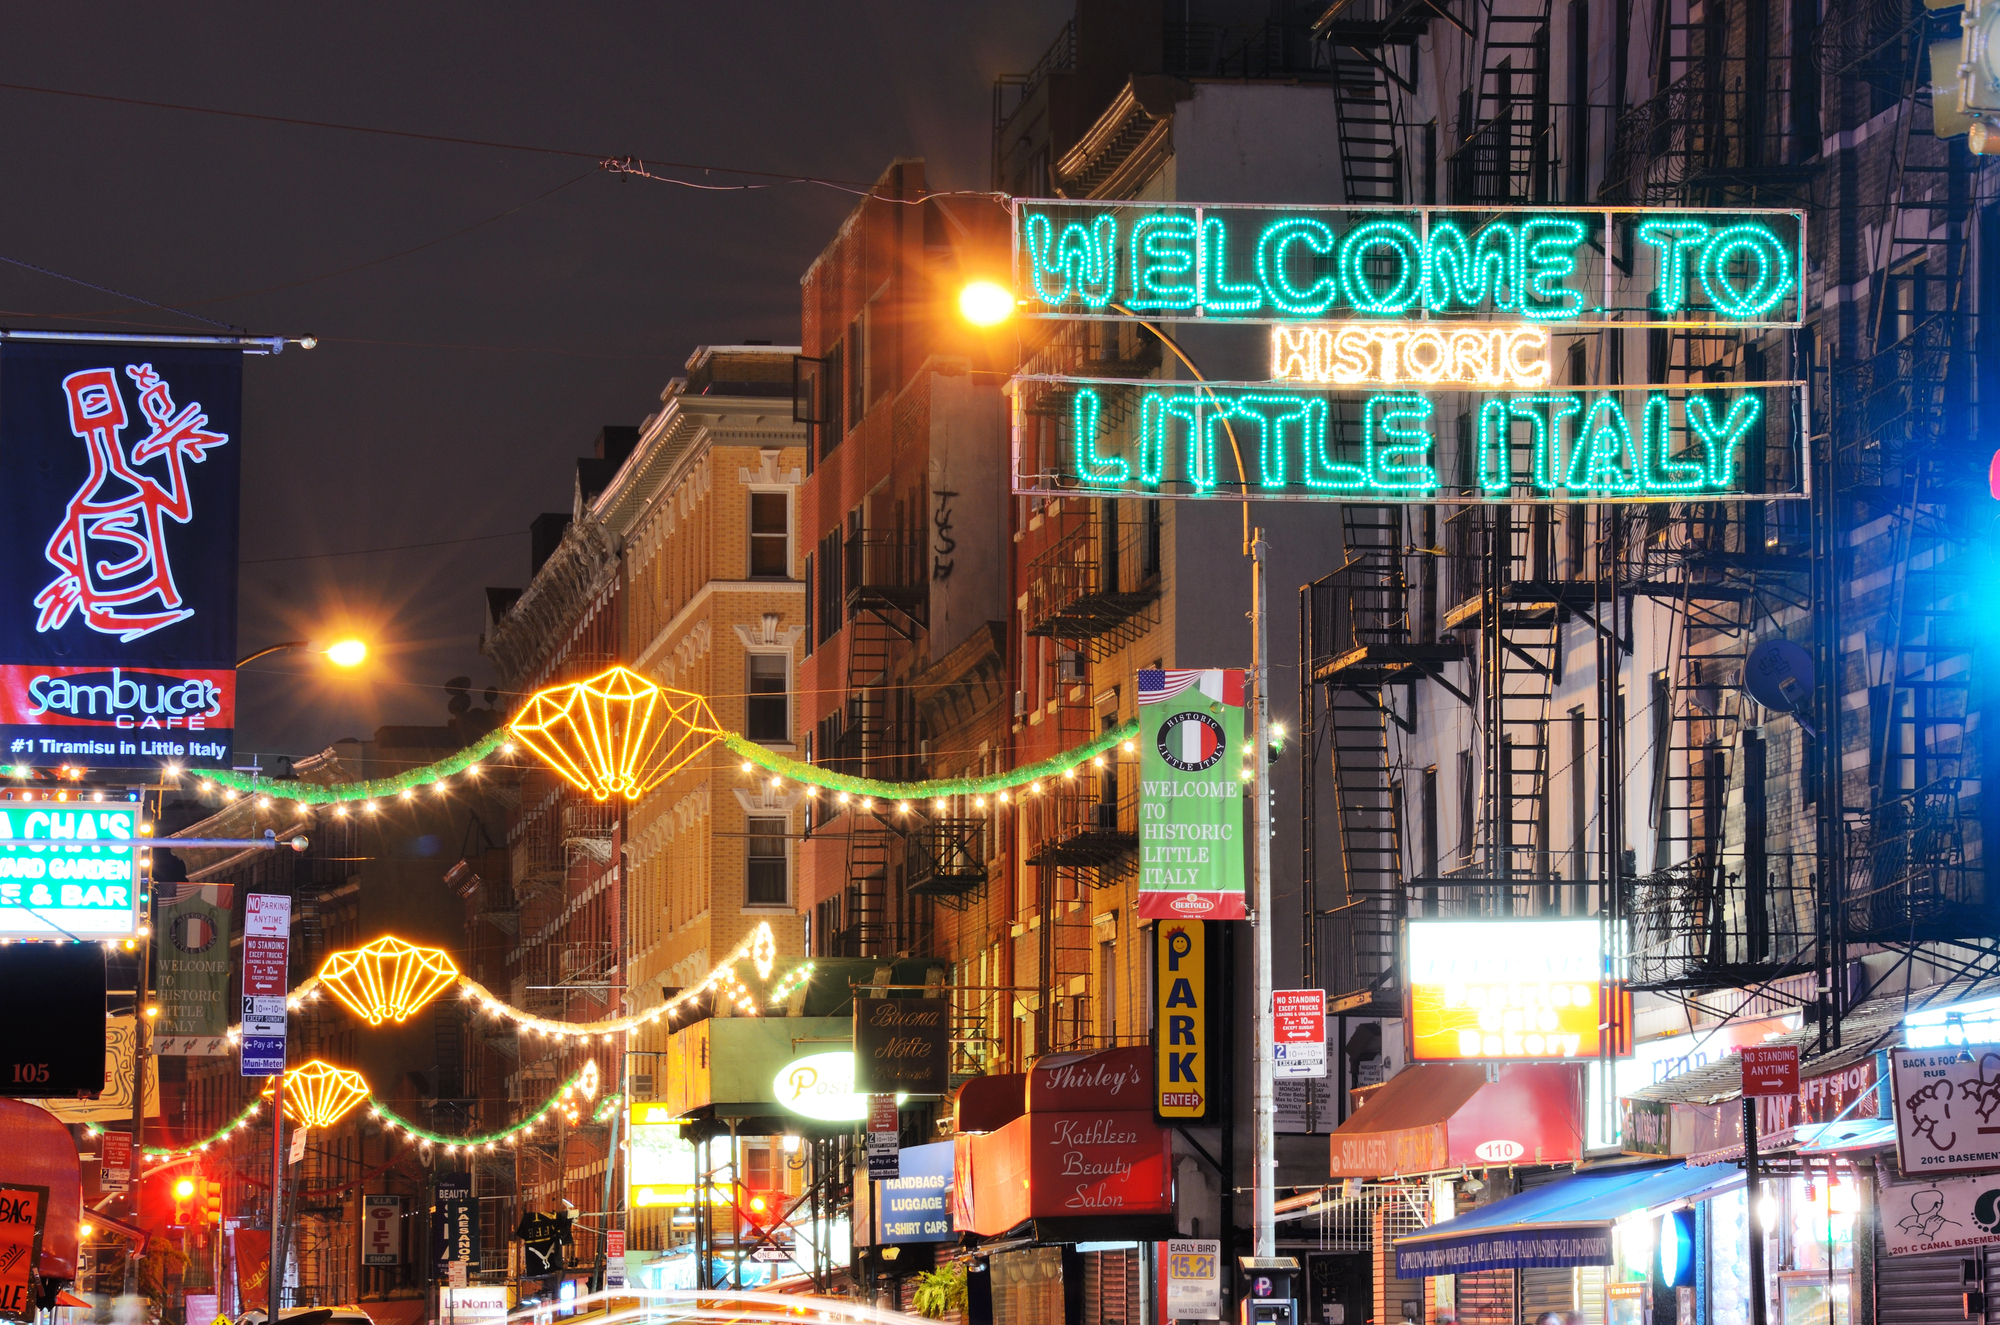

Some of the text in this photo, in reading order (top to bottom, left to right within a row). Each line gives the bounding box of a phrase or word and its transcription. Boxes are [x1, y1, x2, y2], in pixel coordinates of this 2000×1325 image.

[1027, 213, 1796, 318] WELCOME TO
[1273, 326, 1551, 385] HISTORIC
[1074, 388, 1760, 491] LITTLE ITALY
[28, 667, 222, 717] Sambuca's
[116, 713, 206, 731] CAFÉ
[1167, 713, 1218, 729] HISTORIC
[11, 738, 227, 759] #1 Tiramisu in Little Italy
[1159, 742, 1225, 771] LITTLE ITALY
[1143, 781, 1237, 798] WELCOME
[1144, 803, 1165, 819] TO
[24, 811, 131, 854] CHA'S
[1144, 824, 1233, 841] HISTORIC
[1144, 847, 1209, 863] LITTLE
[49, 858, 131, 880] GARDEN
[1144, 868, 1199, 884] ITALY
[29, 884, 53, 905] &
[61, 885, 128, 906] BAR
[248, 897, 289, 911] NO PARKING
[254, 915, 282, 924] ANYTIME
[258, 941, 285, 950] STANDING
[159, 960, 225, 972] WELCOME
[159, 975, 174, 986] TO
[159, 990, 221, 1001] HISTORIC
[1277, 996, 1320, 1004] NO STANDING
[159, 1006, 204, 1017] LITTLE
[245, 997, 252, 1012] 2
[1166, 927, 1198, 1082] PARK
[870, 1003, 939, 1026] Buona
[158, 1021, 196, 1032] ITALY
[253, 1040, 266, 1050] Pay
[874, 1037, 931, 1058] Notte
[1276, 1045, 1285, 1058] 2
[244, 1058, 283, 1068] Muni-Meter
[1744, 1050, 1795, 1062] NO STANDING
[1903, 1057, 1926, 1068] BACK
[1930, 1057, 1936, 1066] &
[12, 1063, 50, 1082] 105
[1751, 1064, 1790, 1075] ANYTIME
[1923, 1069, 1946, 1077] RUB
[1046, 1064, 1141, 1095] Shirley's
[1163, 1094, 1199, 1105] ENTER
[869, 1133, 875, 1143] 2
[1050, 1119, 1137, 1148] Kathleen
[1342, 1140, 1366, 1169] SICILIA
[1367, 1139, 1387, 1169] GIFTS
[1485, 1143, 1513, 1157] 110
[1061, 1151, 1131, 1182] Beauty
[1921, 1155, 1945, 1164] 201C
[886, 1175, 945, 1189] HANDBAGS
[439, 1189, 469, 1198] BEAUTY
[1065, 1183, 1124, 1208] Salon
[891, 1197, 943, 1211] LUGGAGE
[371, 1207, 393, 1253] GIFT
[458, 1207, 470, 1261] PAESANO'S
[885, 1221, 948, 1236] T-SHIRT CAPS
[1170, 1243, 1217, 1253] EARLY BIRD
[1892, 1246, 1909, 1254] 201
[1920, 1241, 1952, 1251] CANAL
[778, 1252, 793, 1260] WAY
[1172, 1257, 1214, 1277] 15.21
[445, 1298, 503, 1308] La Nonna
